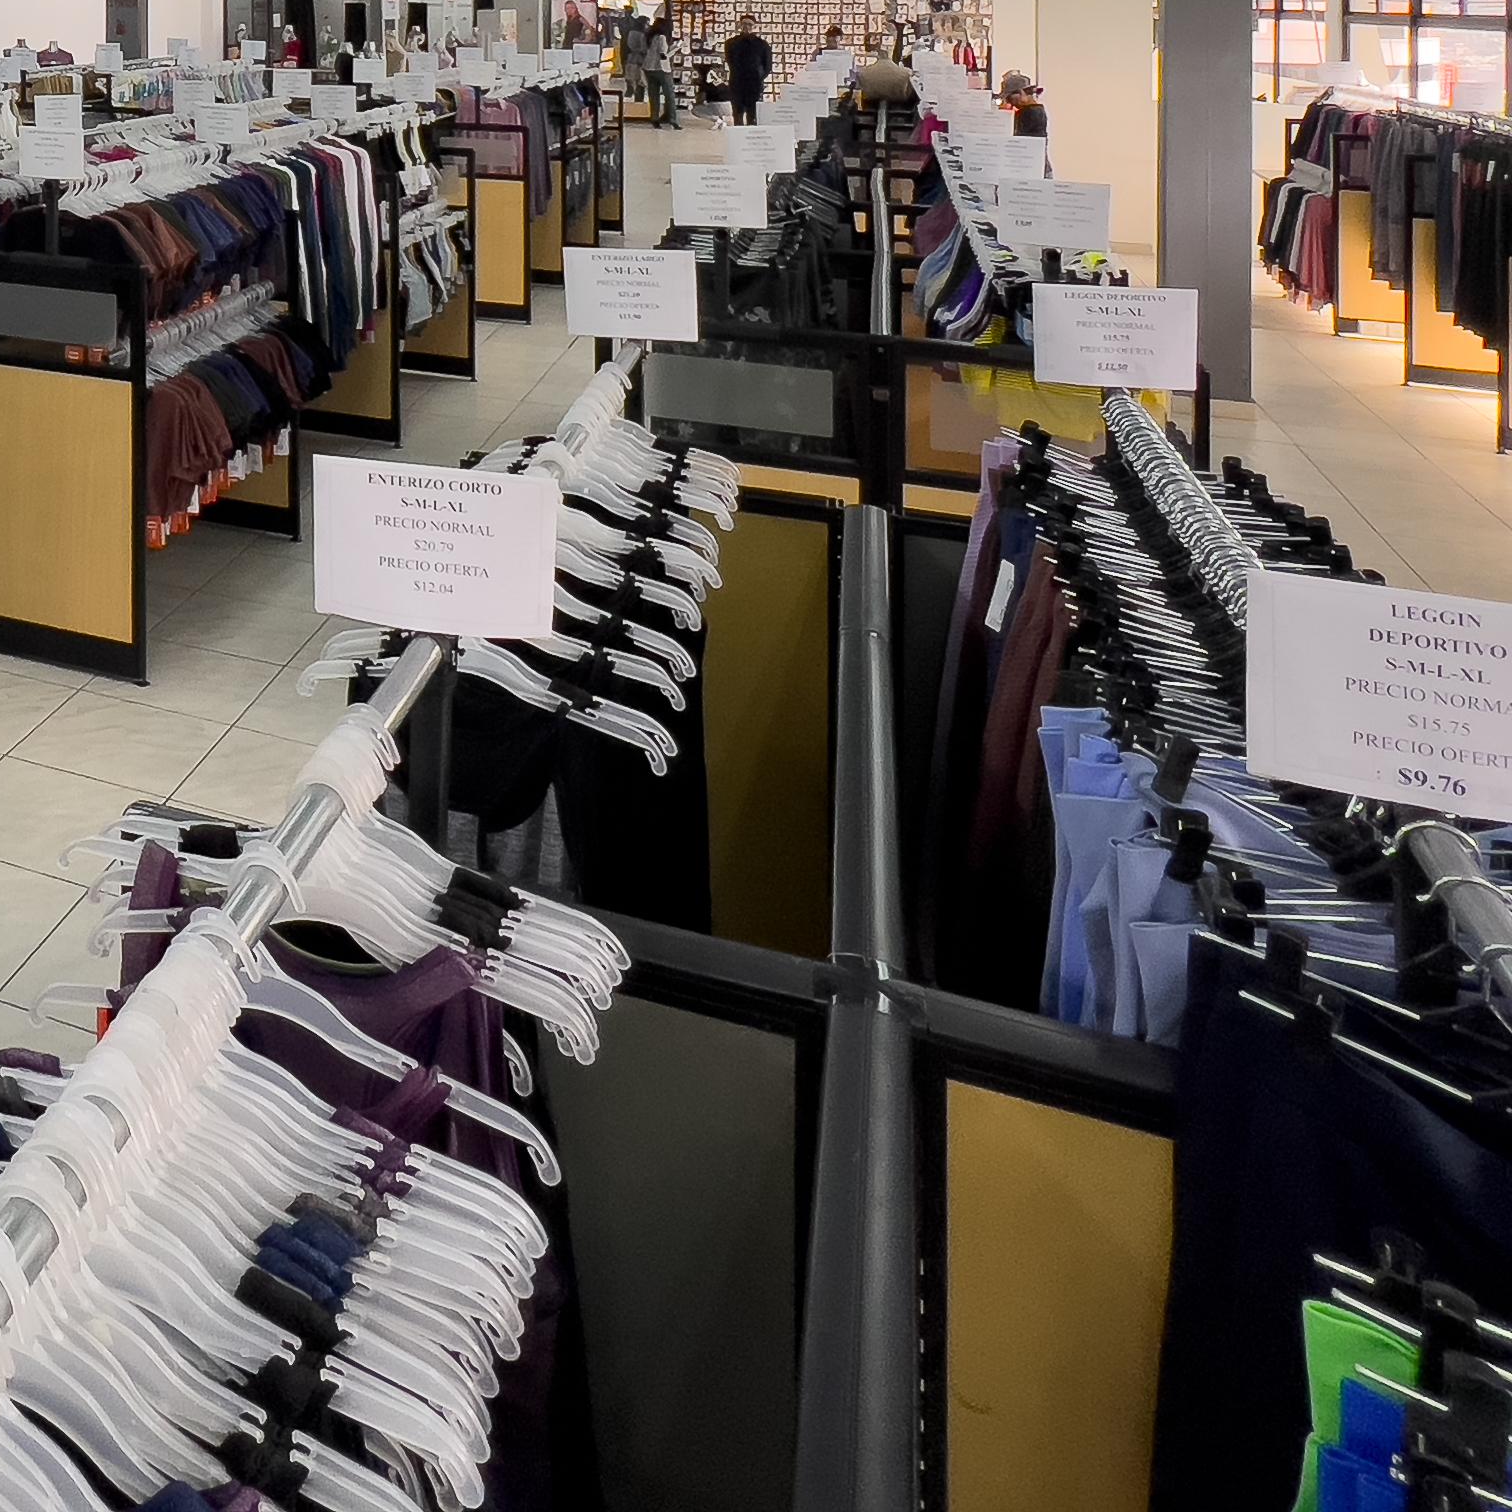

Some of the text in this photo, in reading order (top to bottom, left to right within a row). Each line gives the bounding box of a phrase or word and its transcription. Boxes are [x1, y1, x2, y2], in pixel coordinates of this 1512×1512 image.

[591, 254, 665, 263] ENTERIZO LARGO
[1064, 291, 1167, 303] LEGGIN DEPORTIVO
[1085, 306, 1146, 318] S-M-L-XL
[368, 473, 502, 496] ENTERIZO CORTO
[400, 497, 468, 513] S-M-L-XL
[375, 514, 495, 538] PRECIO NORMAL
[414, 539, 454, 553] $20.79
[379, 555, 489, 579] PRECIO OFERTA
[414, 580, 454, 594] $12.04
[1391, 604, 1482, 628] LEGGIN
[1369, 628, 1508, 660] DEPORTIVO
[1385, 656, 1492, 685] S-M-L-XL
[1345, 676, 1426, 702] PRECIO
[1407, 713, 1472, 737] $15.75
[1353, 730, 1434, 757] PRECIO
[1397, 767, 1467, 796] $9.76
